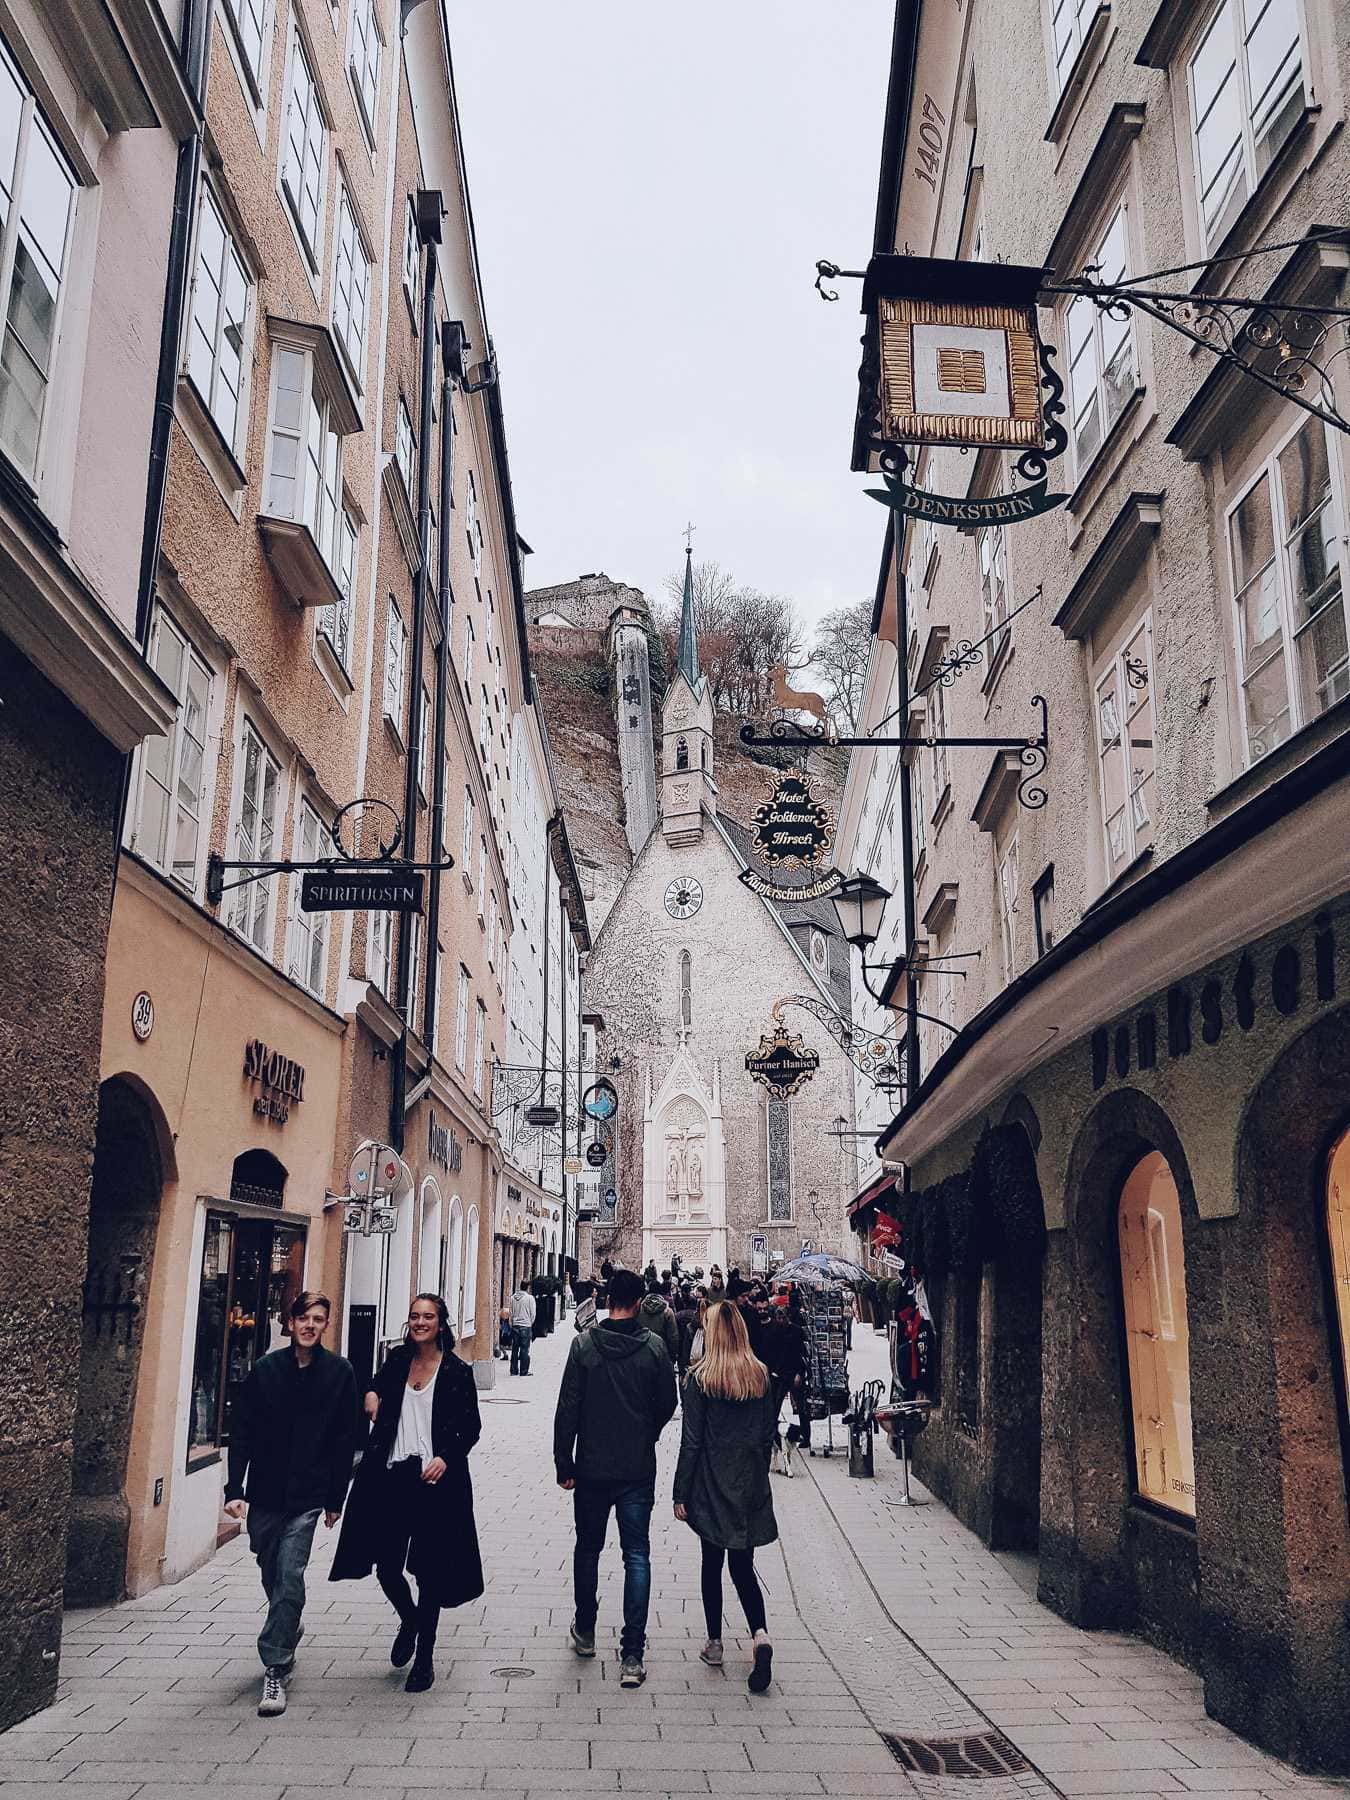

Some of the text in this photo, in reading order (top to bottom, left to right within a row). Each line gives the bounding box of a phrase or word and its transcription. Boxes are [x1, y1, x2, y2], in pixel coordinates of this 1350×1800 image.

[913, 93, 945, 193] 1407
[904, 492, 1035, 519] DENKSTEIN
[776, 791, 807, 803] Hotel
[769, 811, 816, 823] Goldener
[771, 831, 812, 845] Hirsch
[308, 886, 414, 902] SPIRITUOSEN
[743, 871, 841, 900] Kupferschmiedhaus
[135, 996, 151, 1025] 39
[244, 1039, 305, 1103] SPORER
[748, 1059, 817, 1071] Furtner Hanisch
